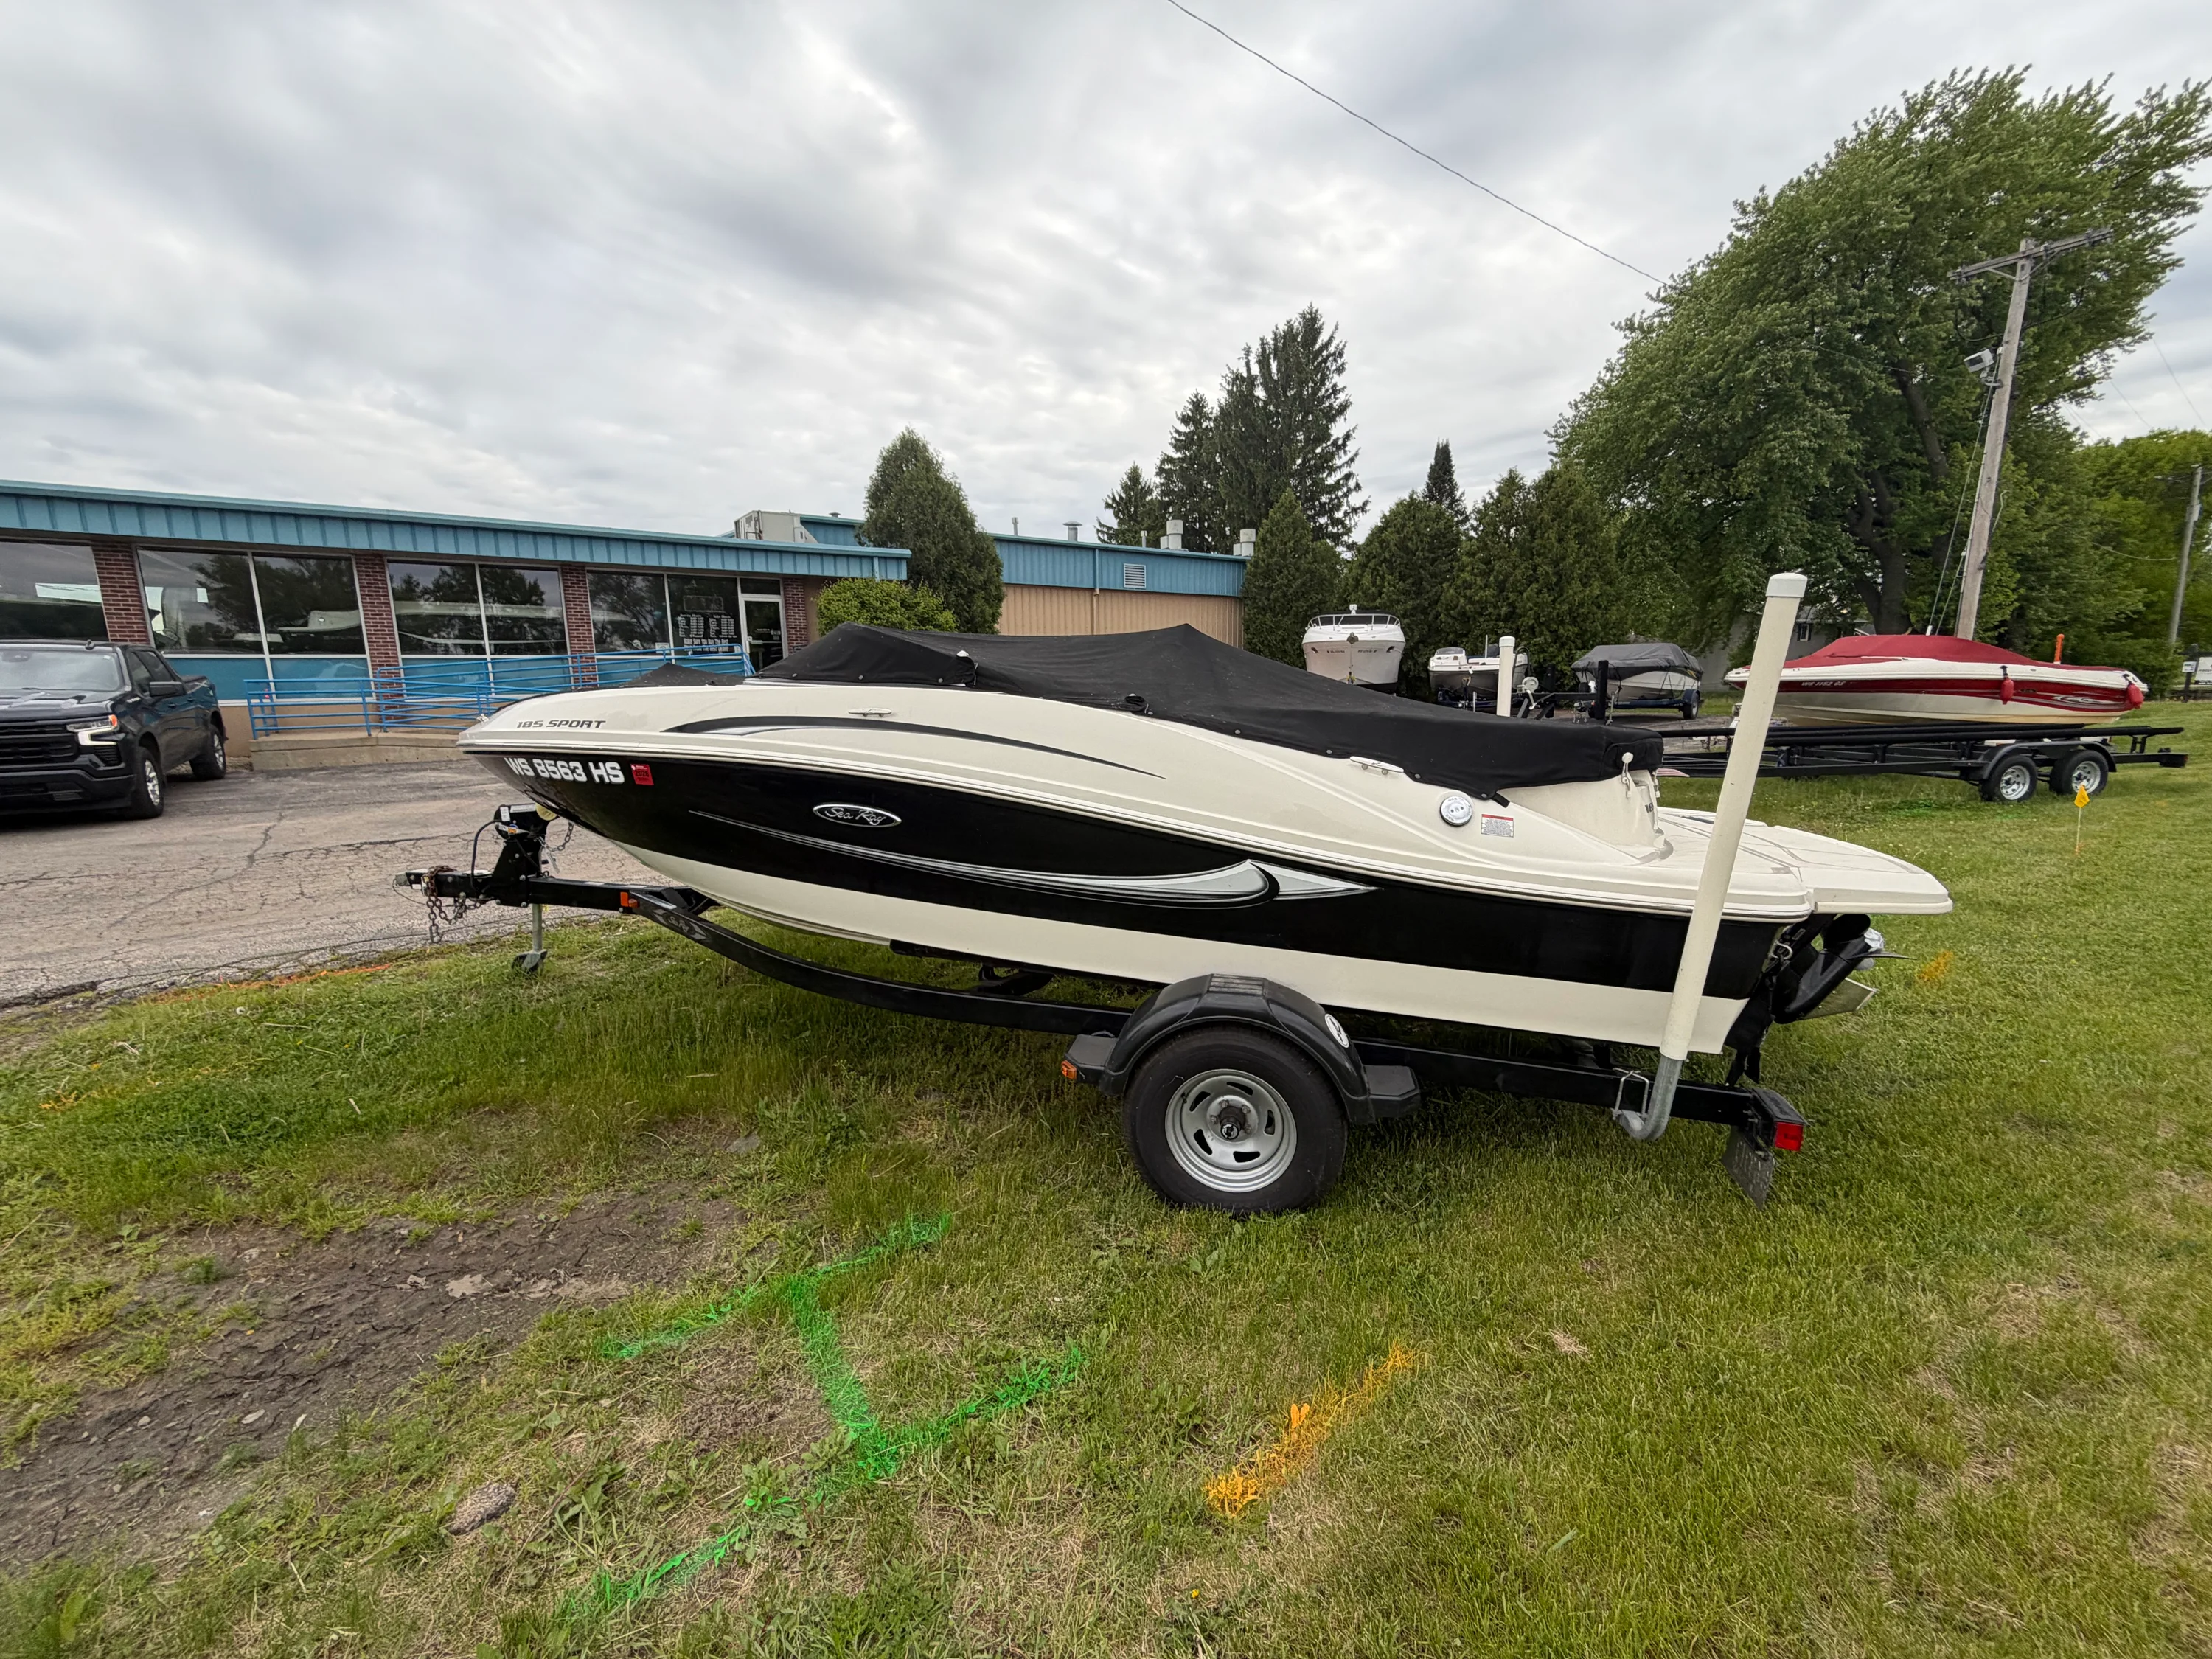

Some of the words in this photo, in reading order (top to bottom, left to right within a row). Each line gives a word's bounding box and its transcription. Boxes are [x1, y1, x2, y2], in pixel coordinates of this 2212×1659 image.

[517, 720, 543, 728] 185
[546, 720, 606, 728] SPORT
[504, 757, 535, 776] WS
[532, 759, 588, 783] 8563
[588, 762, 625, 785] HS
[824, 807, 853, 819] Sea
[855, 810, 886, 825] Ray
